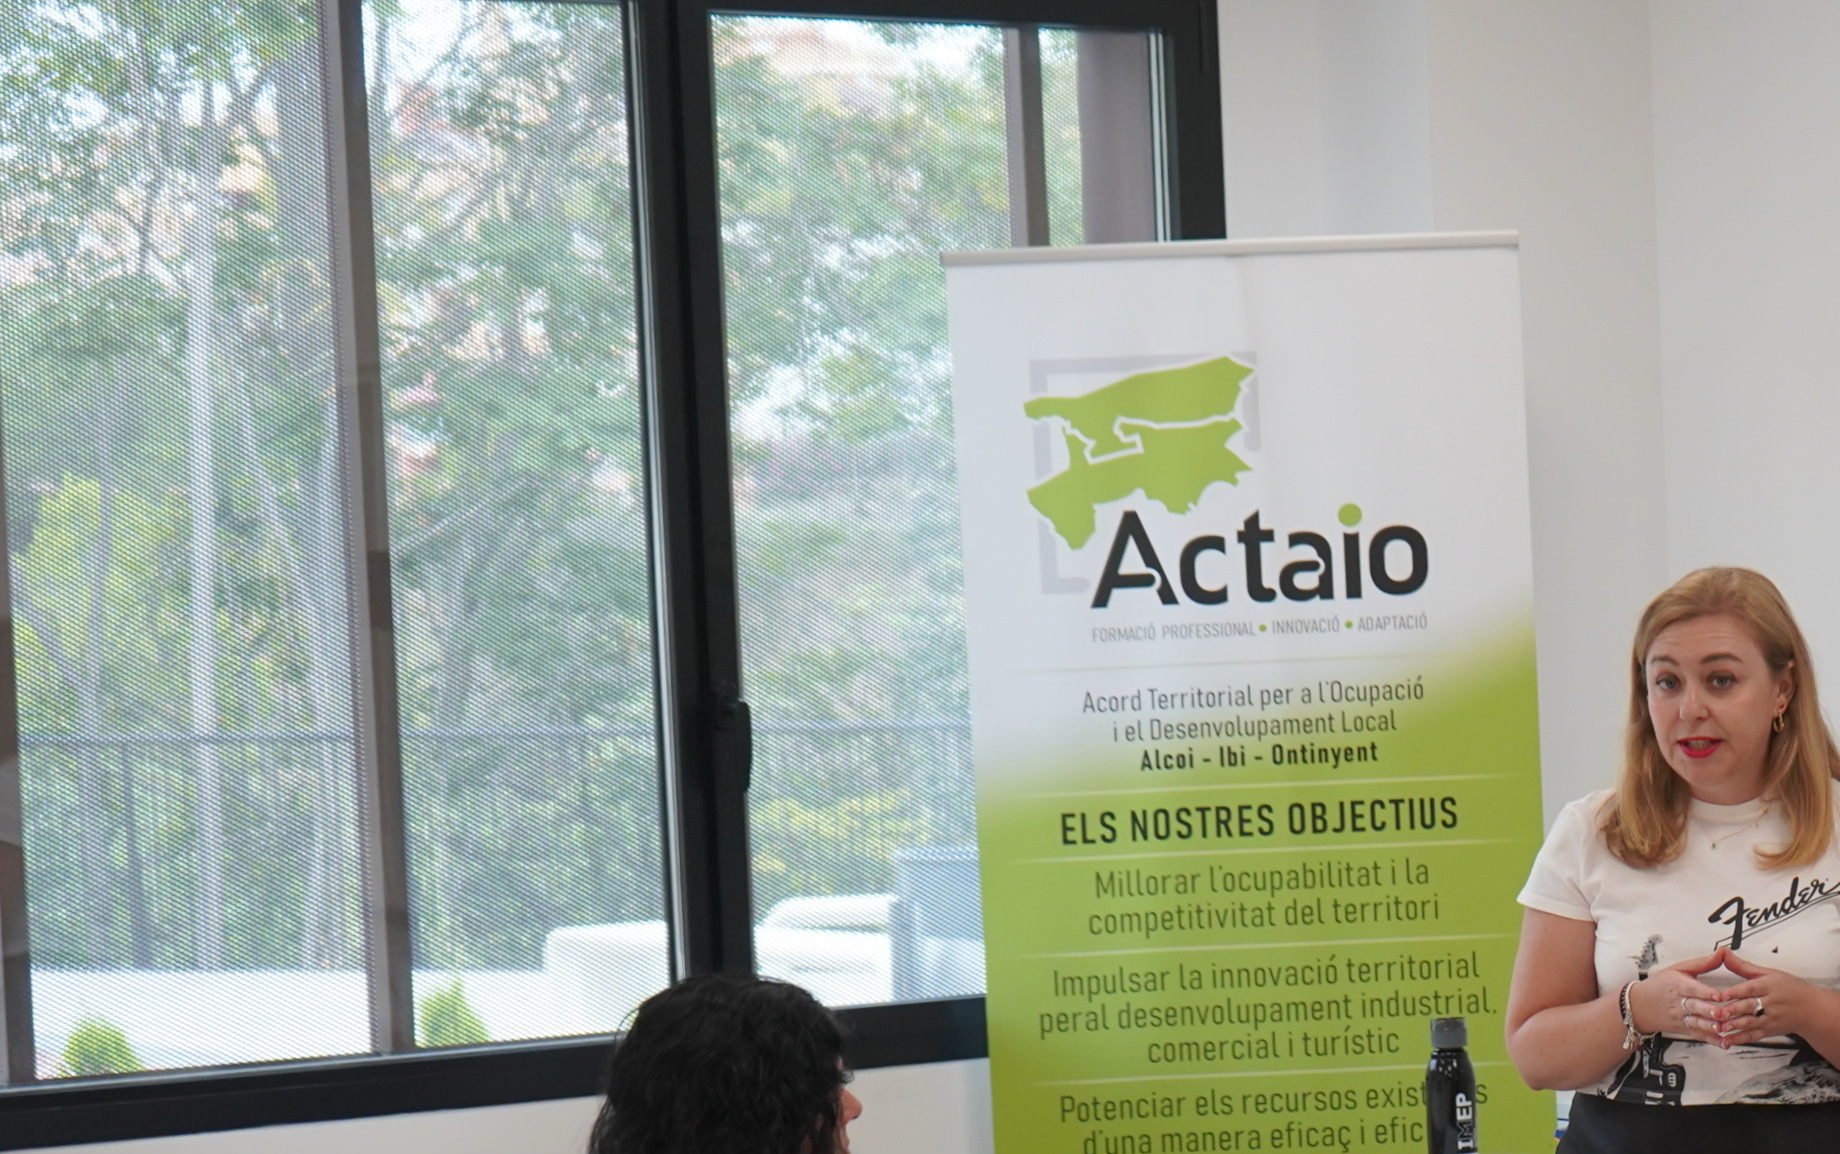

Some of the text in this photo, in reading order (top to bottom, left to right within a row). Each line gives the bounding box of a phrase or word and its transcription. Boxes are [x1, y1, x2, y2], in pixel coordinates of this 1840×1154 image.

[1091, 503, 1429, 608] Actaio
[1092, 611, 1428, 643] FORMACIÓ PROFESSIONAL INNOVACIÓ ADAPTACIÓ
[1083, 675, 1424, 713] Acord Territorial per a l'Ocupació
[1113, 709, 1397, 742] i el Desenvolupament Local
[1141, 748, 1194, 771] Alcoi
[1219, 745, 1245, 767] Ibi
[1271, 742, 1378, 772] Ontinyent
[1061, 797, 1457, 845] ELS NOSTRES OBJECTIUS
[1095, 858, 1429, 898] Millorar l'ocupabilitat i la
[1089, 893, 1439, 939] competitivitat del territori
[1054, 951, 1479, 1003] Impulsar la innovació territorial
[1040, 1004, 1109, 1041] peral
[1118, 995, 1352, 1036] desenvolupament
[1148, 1025, 1399, 1063] comercial i turístic
[1060, 1082, 1488, 1123] Potenciar els recursos exists
[1456, 1092, 1473, 1150] IMEP
[1161, 1129, 1261, 1153] manera
[1270, 1121, 1351, 1153] eficaç
[1360, 1119, 1365, 1145] i
[1374, 1115, 1424, 1143] efic
